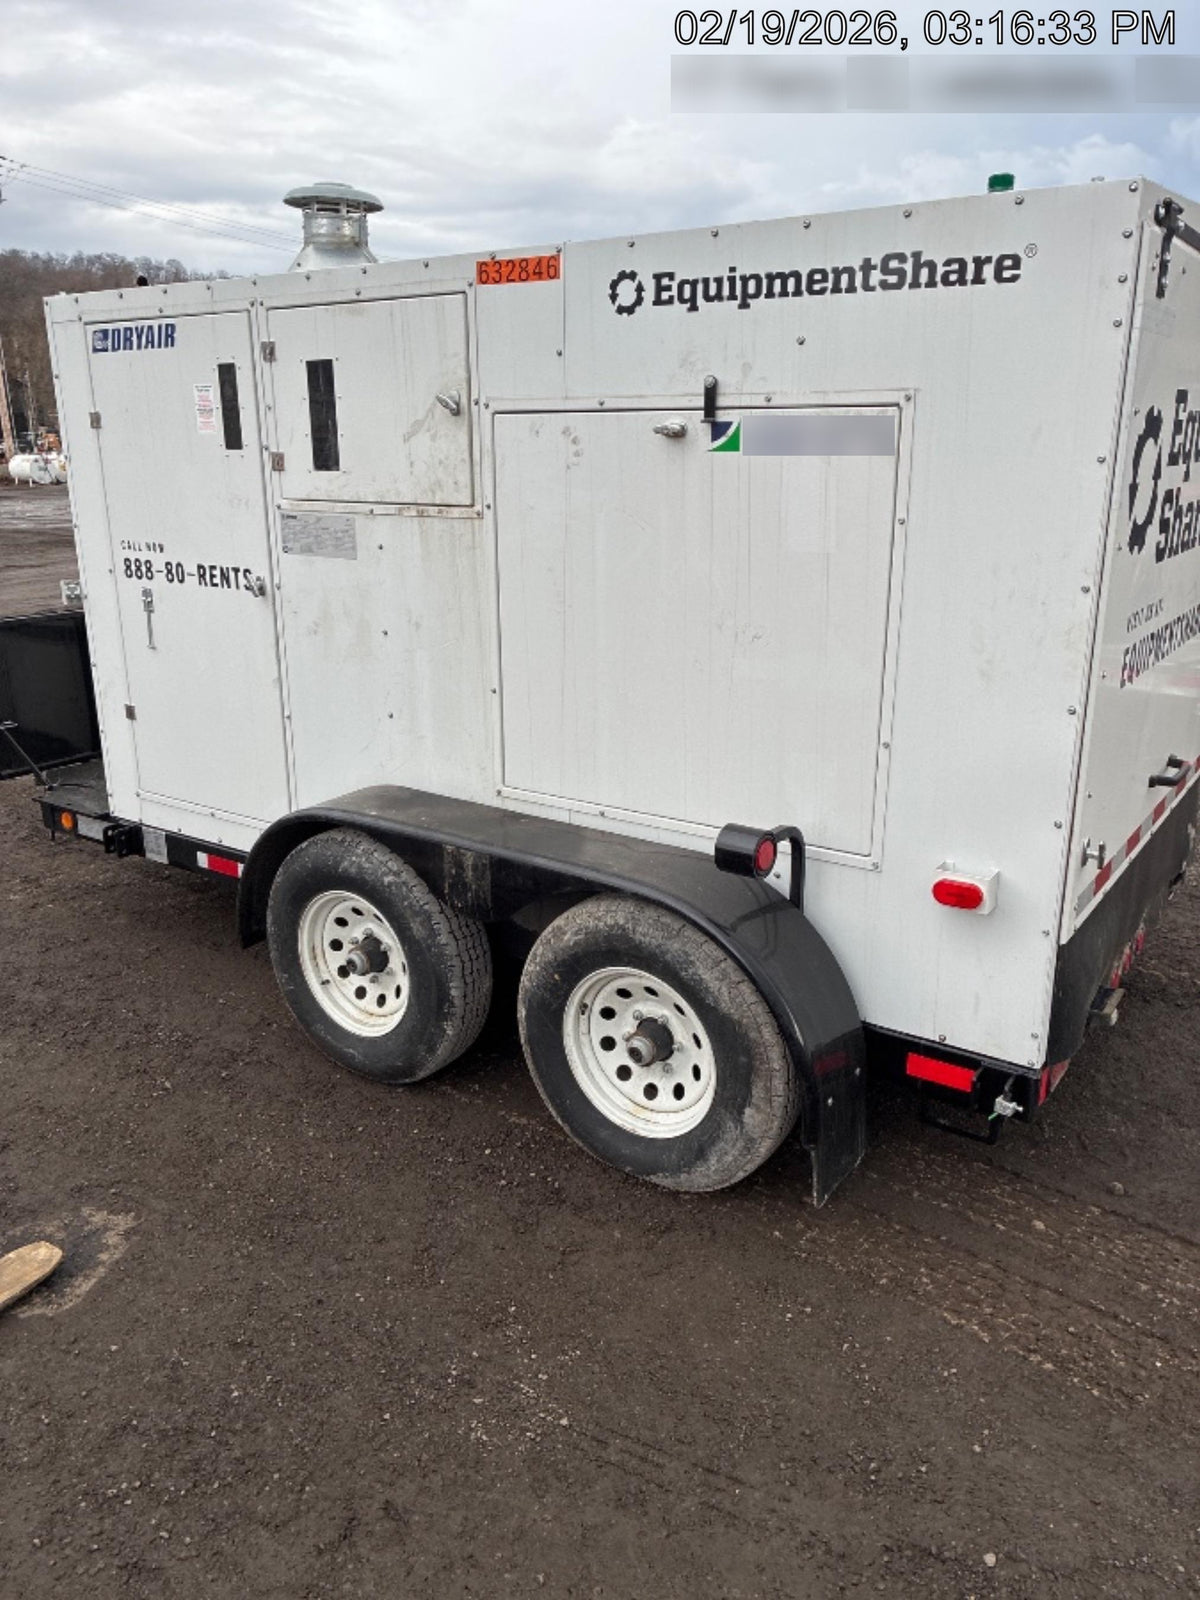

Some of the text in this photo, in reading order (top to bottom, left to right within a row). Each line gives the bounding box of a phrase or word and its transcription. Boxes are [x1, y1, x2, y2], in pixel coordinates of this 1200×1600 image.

[479, 255, 558, 285] 632846
[111, 323, 176, 352] DRYAIR
[120, 539, 142, 552] CALL
[123, 557, 254, 592] 888-80-RENTS
